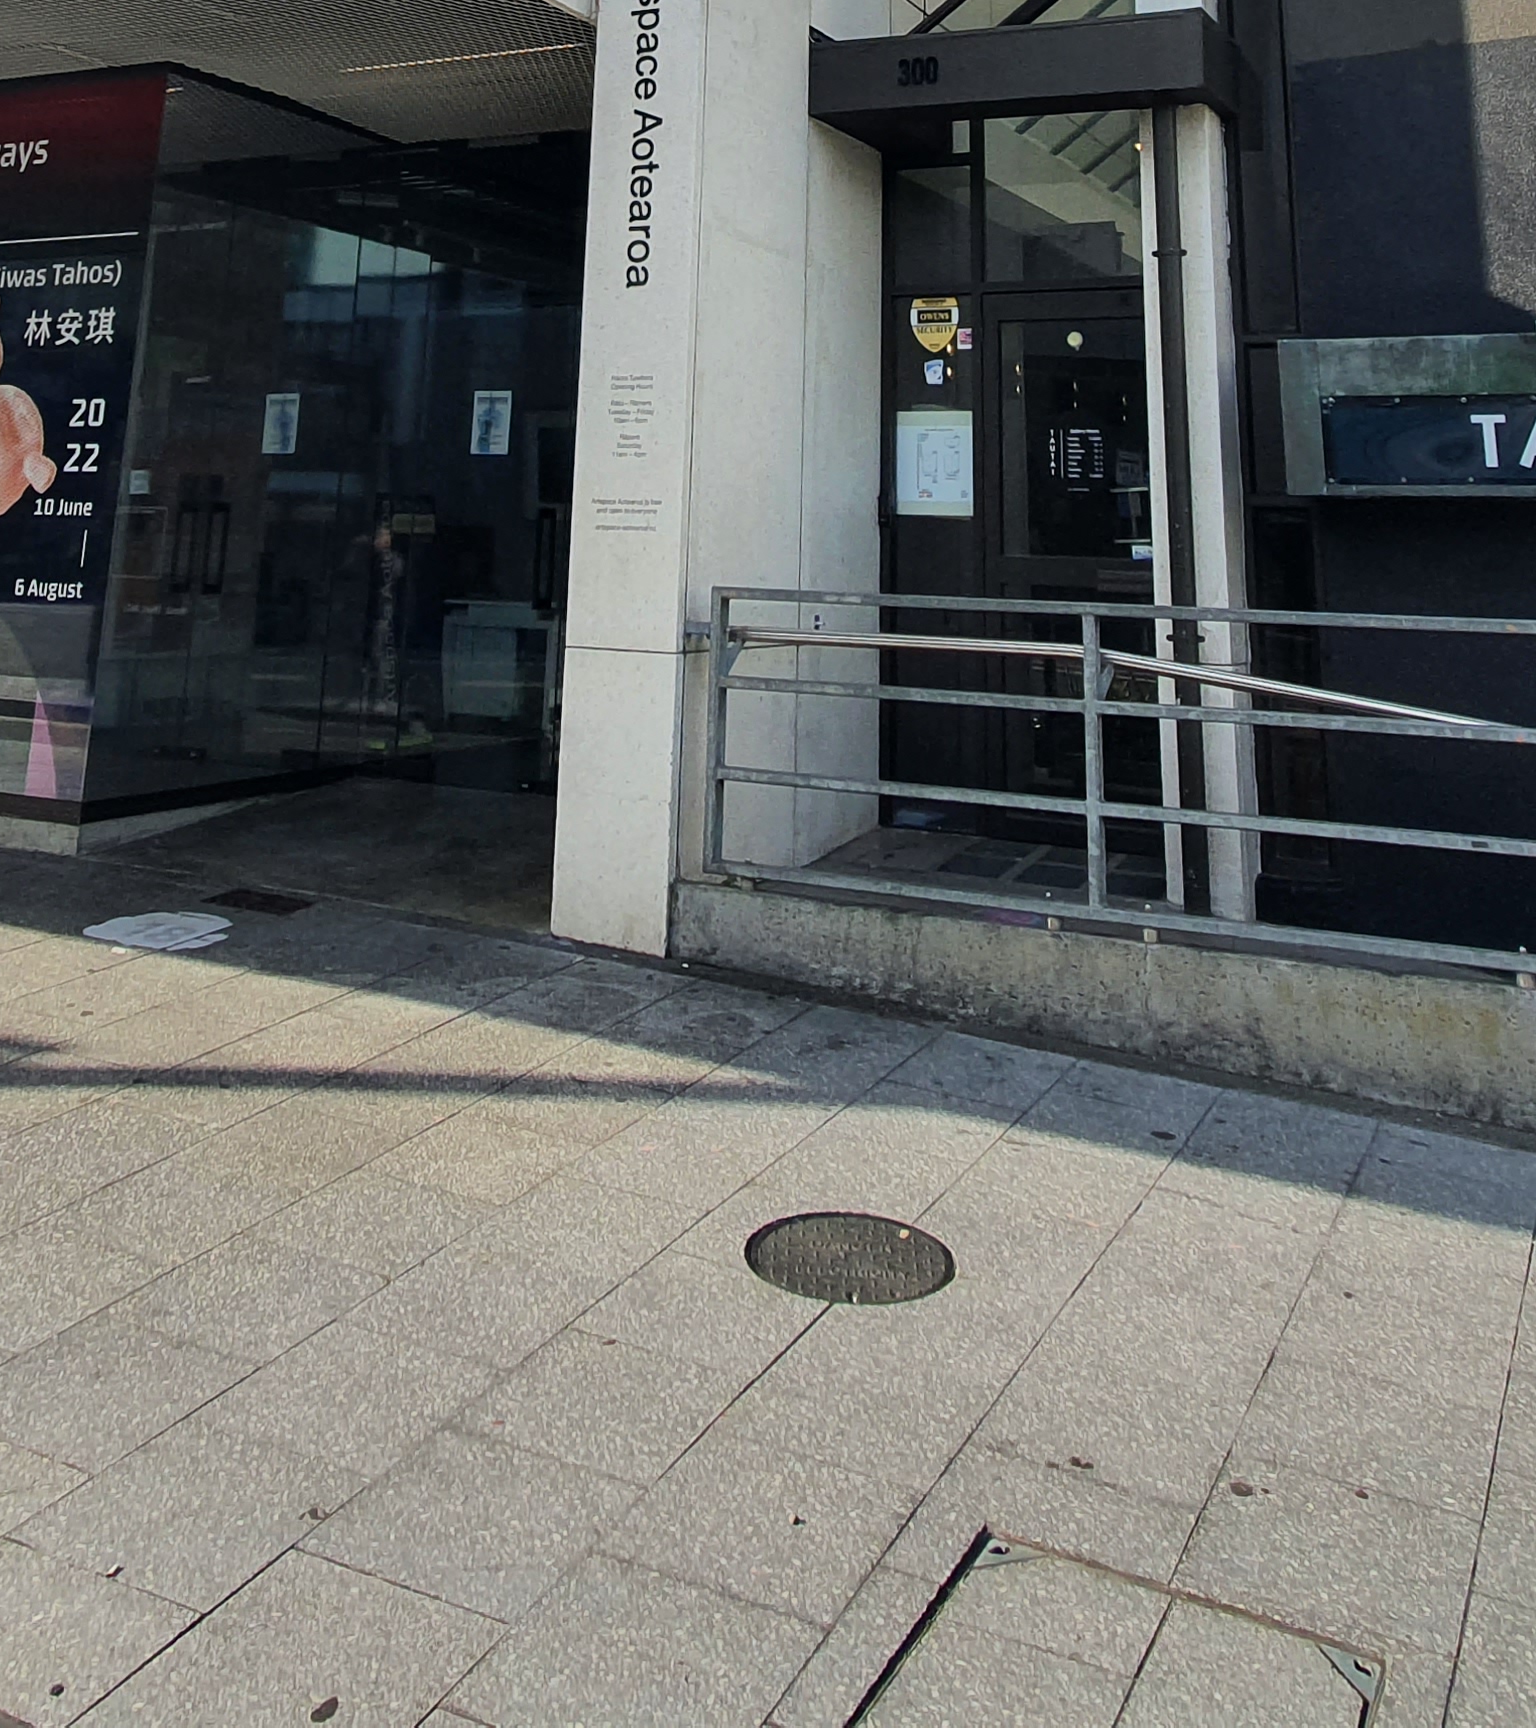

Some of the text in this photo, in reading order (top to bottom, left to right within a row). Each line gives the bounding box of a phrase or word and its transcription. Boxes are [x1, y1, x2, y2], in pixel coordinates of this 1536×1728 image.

[897, 56, 939, 87] 300
[626, 108, 663, 289] Aotearoa
[52, 259, 123, 287] Tahos)
[23, 306, 117, 347] 林安琪
[69, 398, 106, 427] 20
[63, 443, 100, 472] 22
[33, 498, 93, 517] 10 June
[14, 578, 83, 601] 6 August
